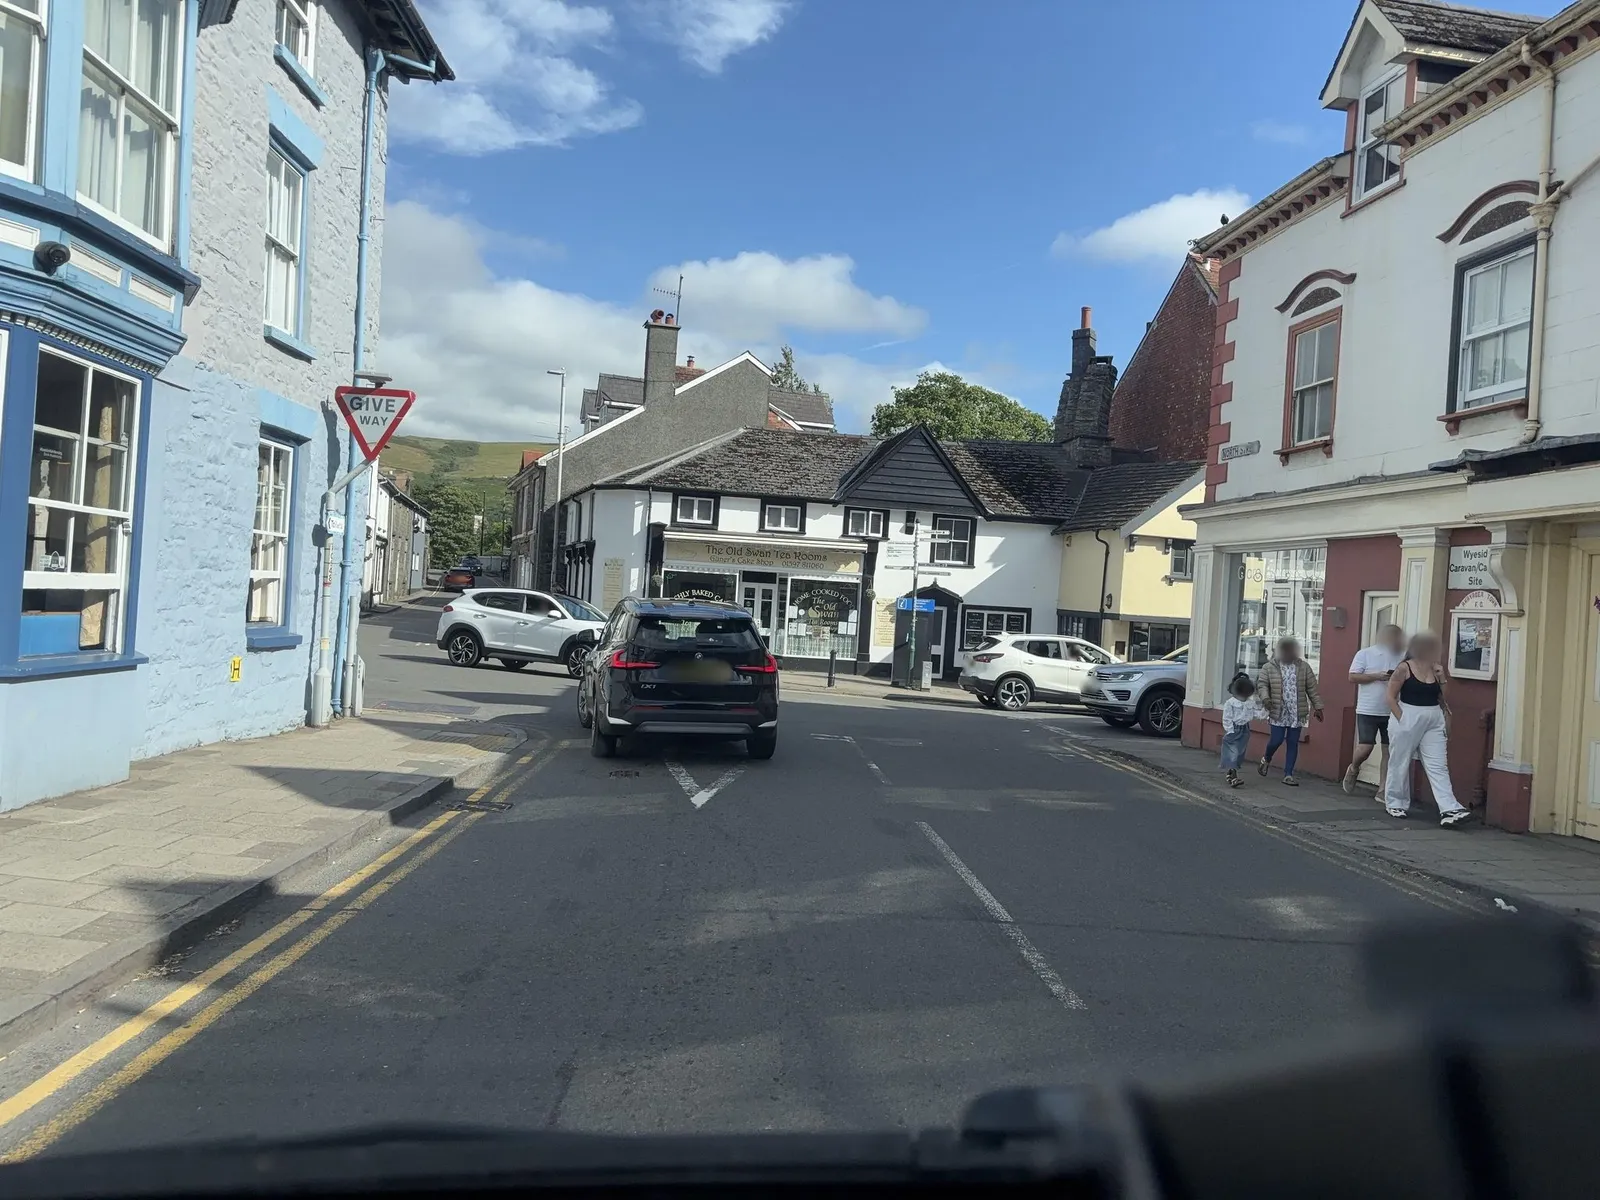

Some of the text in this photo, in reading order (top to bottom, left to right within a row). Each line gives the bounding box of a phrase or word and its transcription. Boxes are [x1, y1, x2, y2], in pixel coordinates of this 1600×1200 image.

[349, 396, 396, 413] GIVE
[360, 415, 388, 426] WAY
[705, 544, 828, 562] The Old Swan Tea Rooms
[1463, 549, 1489, 560] Wyesid
[756, 558, 774, 567] Shop
[1449, 562, 1488, 574] Caravan/Ca
[1468, 576, 1483, 586] Site
[691, 589, 714, 598] BAKED
[792, 591, 811, 606] HOME
[811, 588, 839, 598] COOKED
[812, 595, 825, 604] The
[814, 605, 839, 618] Swan
[823, 602, 838, 610] Old
